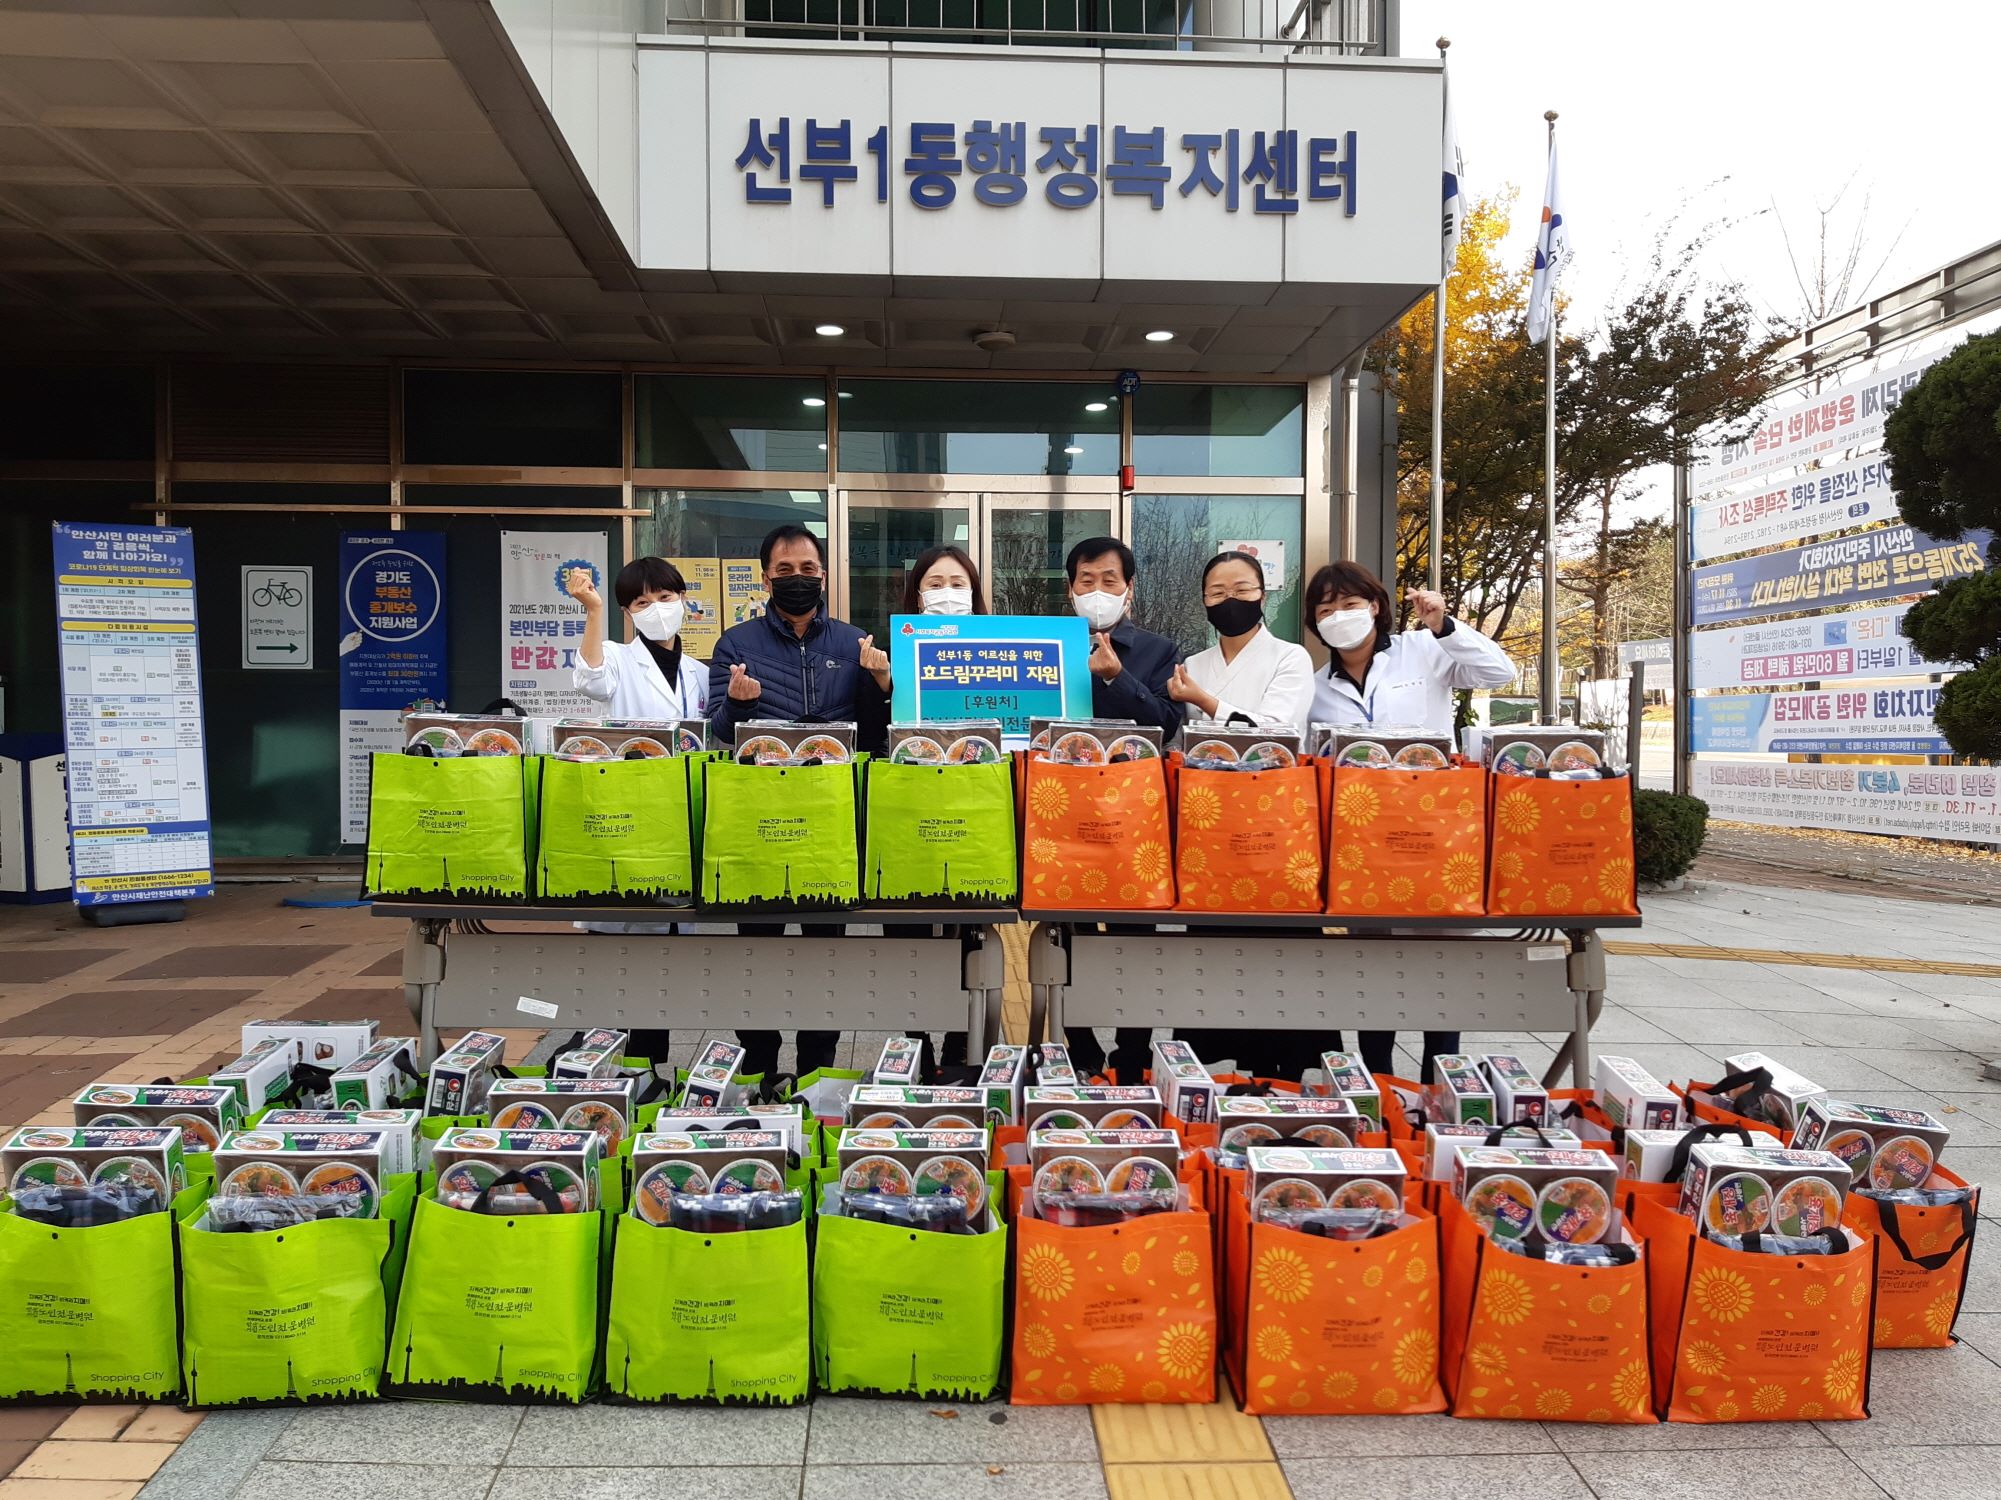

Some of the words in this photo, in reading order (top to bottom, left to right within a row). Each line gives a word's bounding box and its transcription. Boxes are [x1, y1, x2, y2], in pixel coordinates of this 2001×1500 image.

[735, 116, 1356, 217] 선부1동행정복지센터
[375, 571, 412, 583] 경기도
[375, 586, 412, 599] 부동산
[369, 617, 418, 629] 지원사업
[509, 620, 560, 637] 본인부담
[936, 650, 972, 661] 선부1동
[978, 650, 1018, 661] 어르신을
[1023, 650, 1043, 661] 위한
[920, 664, 1018, 684] 효드림꾸러미
[1026, 666, 1059, 685] 지원
[461, 874, 498, 882] Shopping
[629, 876, 665, 884] Shopping
[960, 878, 994, 886] Shopping
[802, 881, 837, 890] Shopping
[91, 1373, 140, 1384] Shopping
[312, 1372, 362, 1387] Shopping
[519, 1369, 565, 1382] Shopping
[730, 1375, 776, 1388] Shopping
